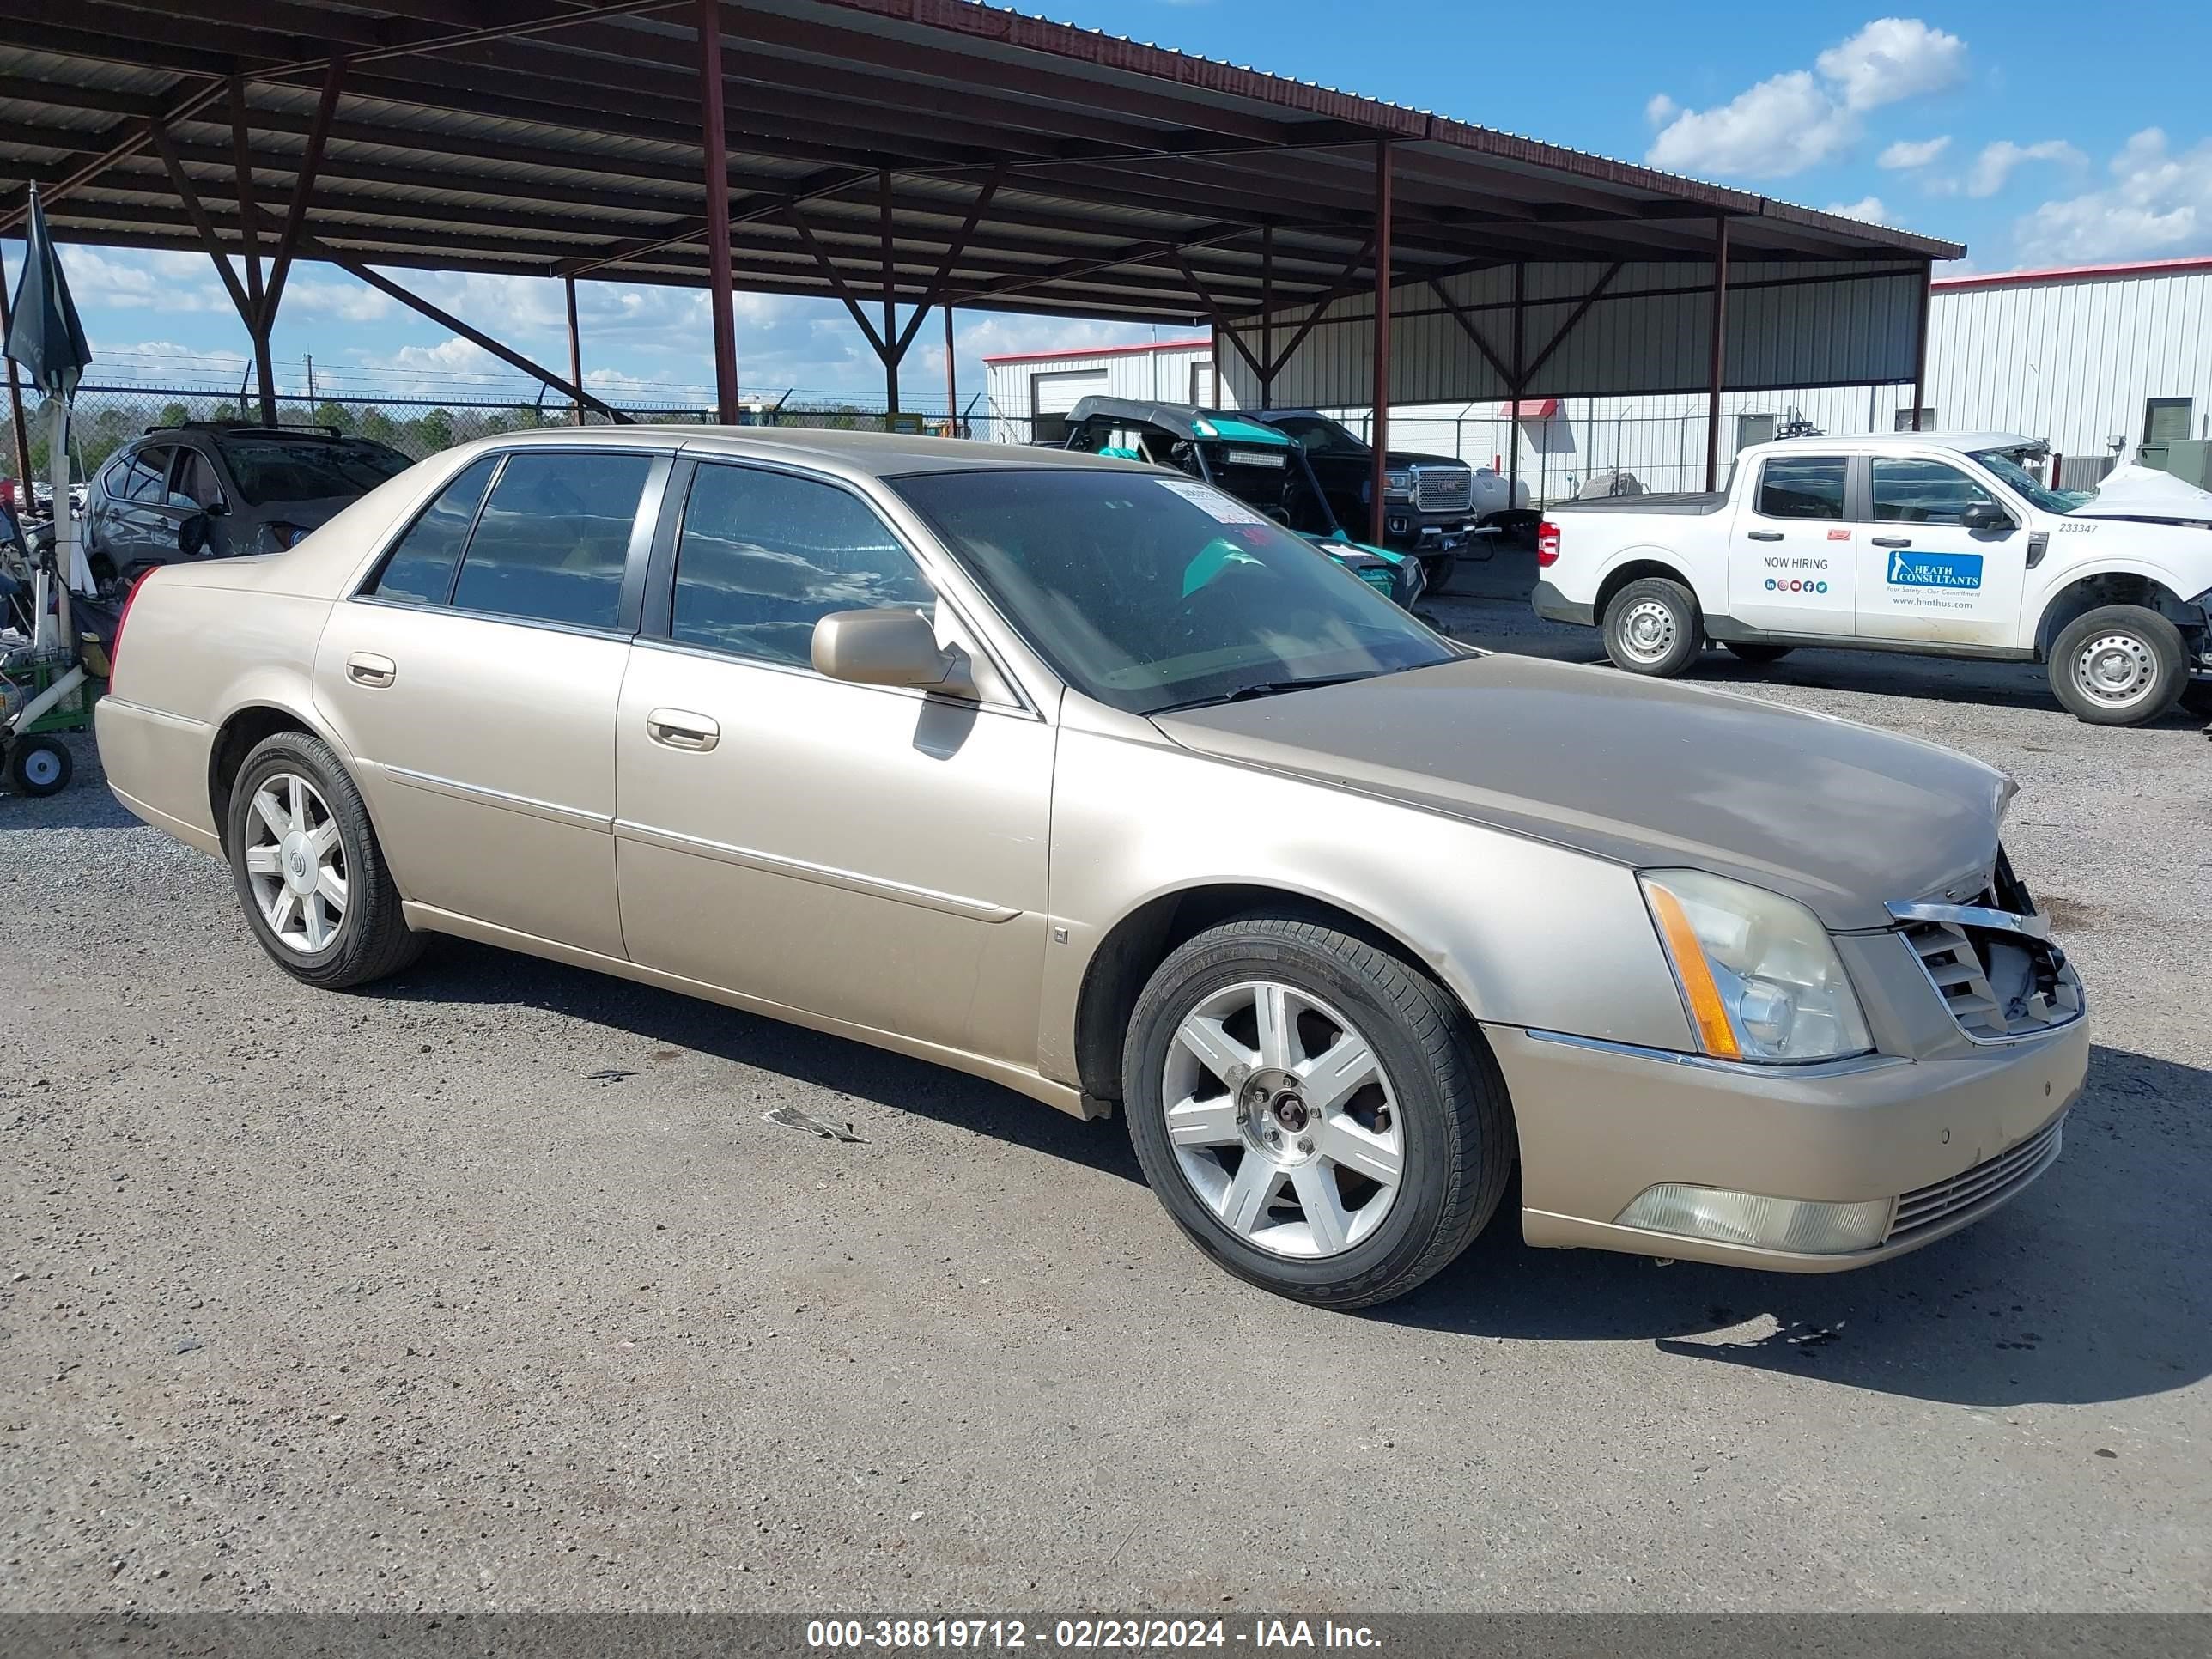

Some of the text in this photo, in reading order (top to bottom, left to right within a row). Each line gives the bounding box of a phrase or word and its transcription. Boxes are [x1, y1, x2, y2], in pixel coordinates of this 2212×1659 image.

[2058, 522, 2099, 533] 233347
[1764, 556, 1828, 570] NOW HIRING
[1914, 565, 1953, 575] HEATH
[1899, 573, 1979, 586] CONSULTANTS
